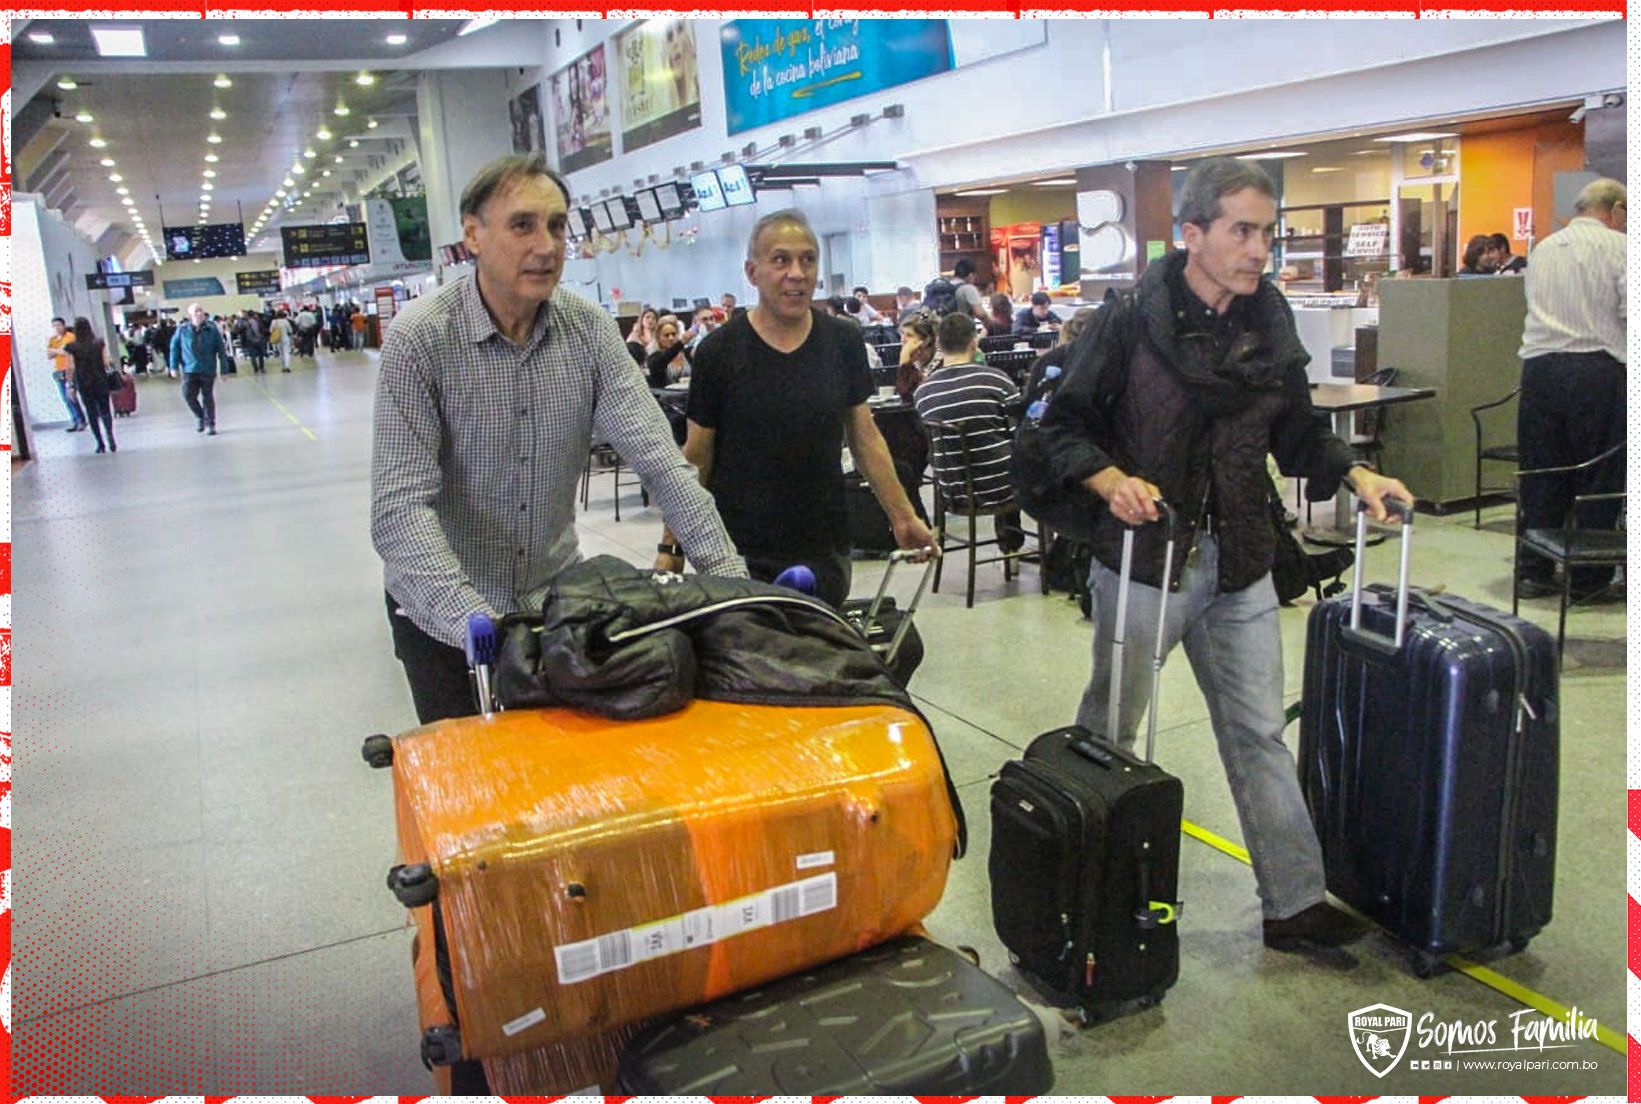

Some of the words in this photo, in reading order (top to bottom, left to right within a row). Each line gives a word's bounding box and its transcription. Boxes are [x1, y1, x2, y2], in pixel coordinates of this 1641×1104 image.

[737, 34, 770, 78] Redes
[773, 25, 786, 55] de
[750, 69, 761, 99] de
[763, 65, 774, 97] la
[776, 64, 806, 86] cocina
[808, 43, 860, 79] boliviana
